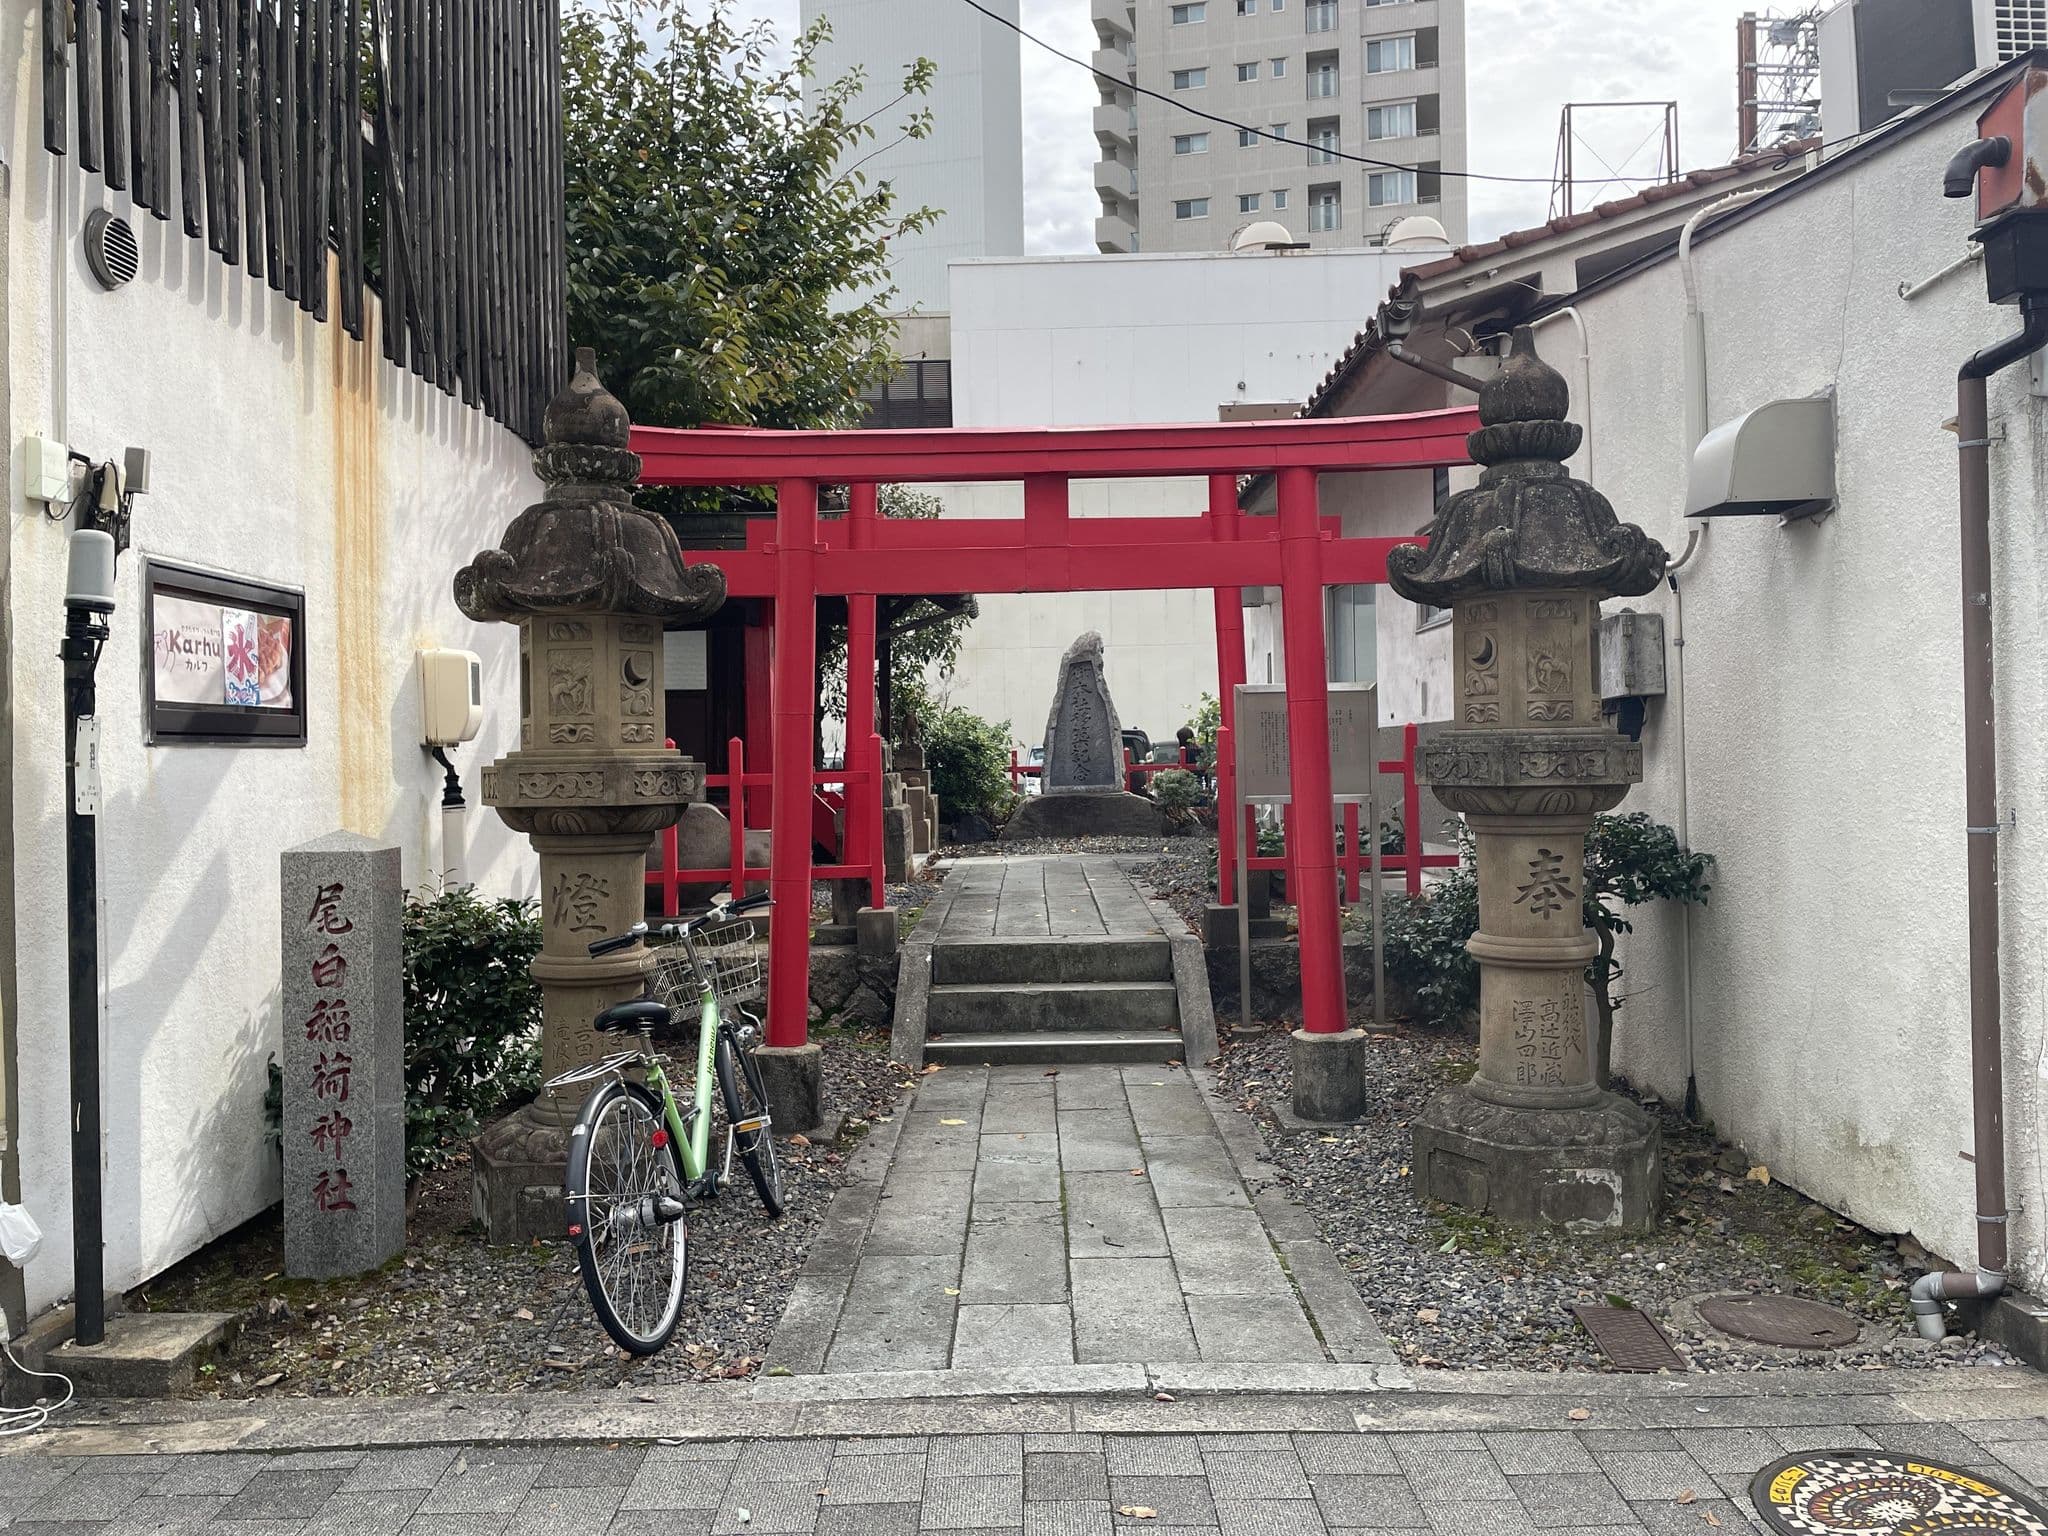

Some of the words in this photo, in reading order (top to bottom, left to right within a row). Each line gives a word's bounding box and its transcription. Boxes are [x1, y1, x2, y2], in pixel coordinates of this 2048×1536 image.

[169, 628, 221, 659] Karhu
[185, 659, 208, 672] カルフ
[227, 623, 257, 683] 氷
[552, 872, 610, 934] 燈
[1512, 849, 1576, 920] 奉
[305, 882, 357, 1213] 尾白稲荷神社
